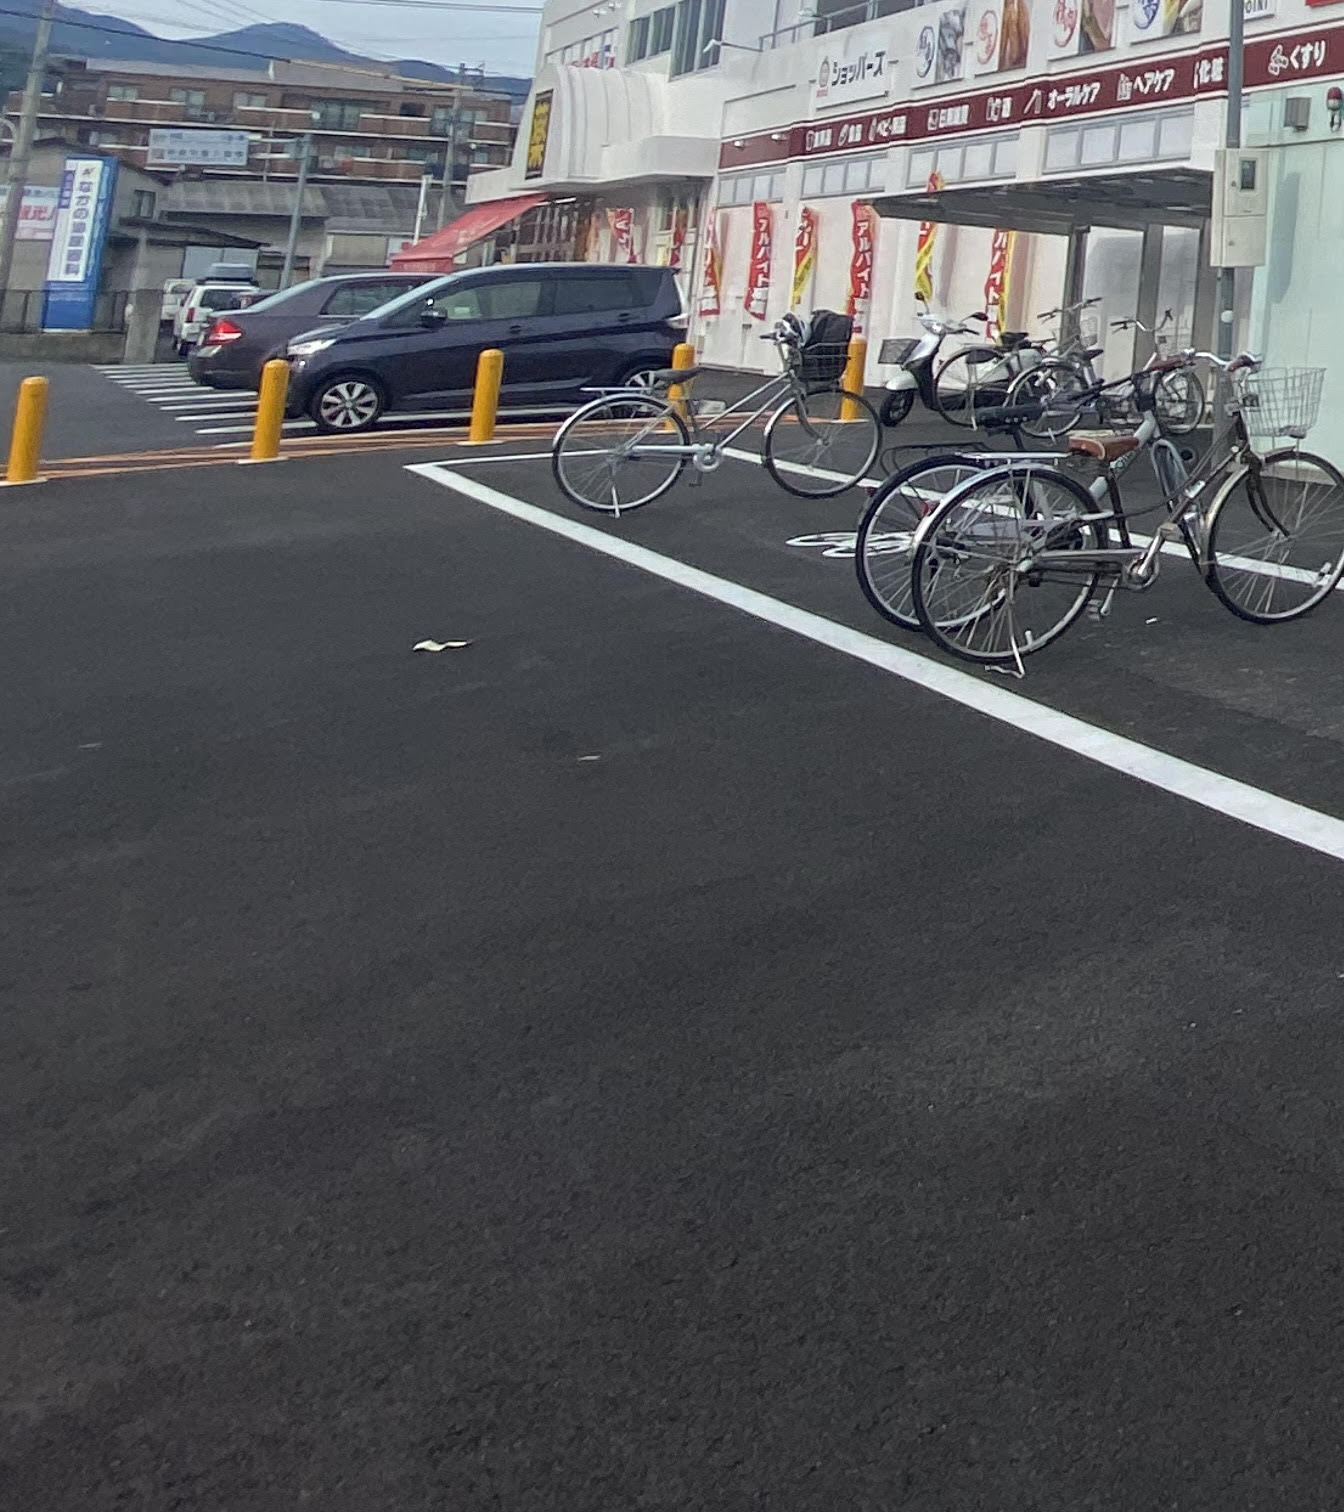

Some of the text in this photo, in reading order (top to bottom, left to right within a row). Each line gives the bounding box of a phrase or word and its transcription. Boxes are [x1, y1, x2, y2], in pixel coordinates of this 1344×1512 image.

[1289, 40, 1327, 70] くすり
[1133, 68, 1177, 95] ヘアケア
[989, 231, 1008, 305] ルバイト
